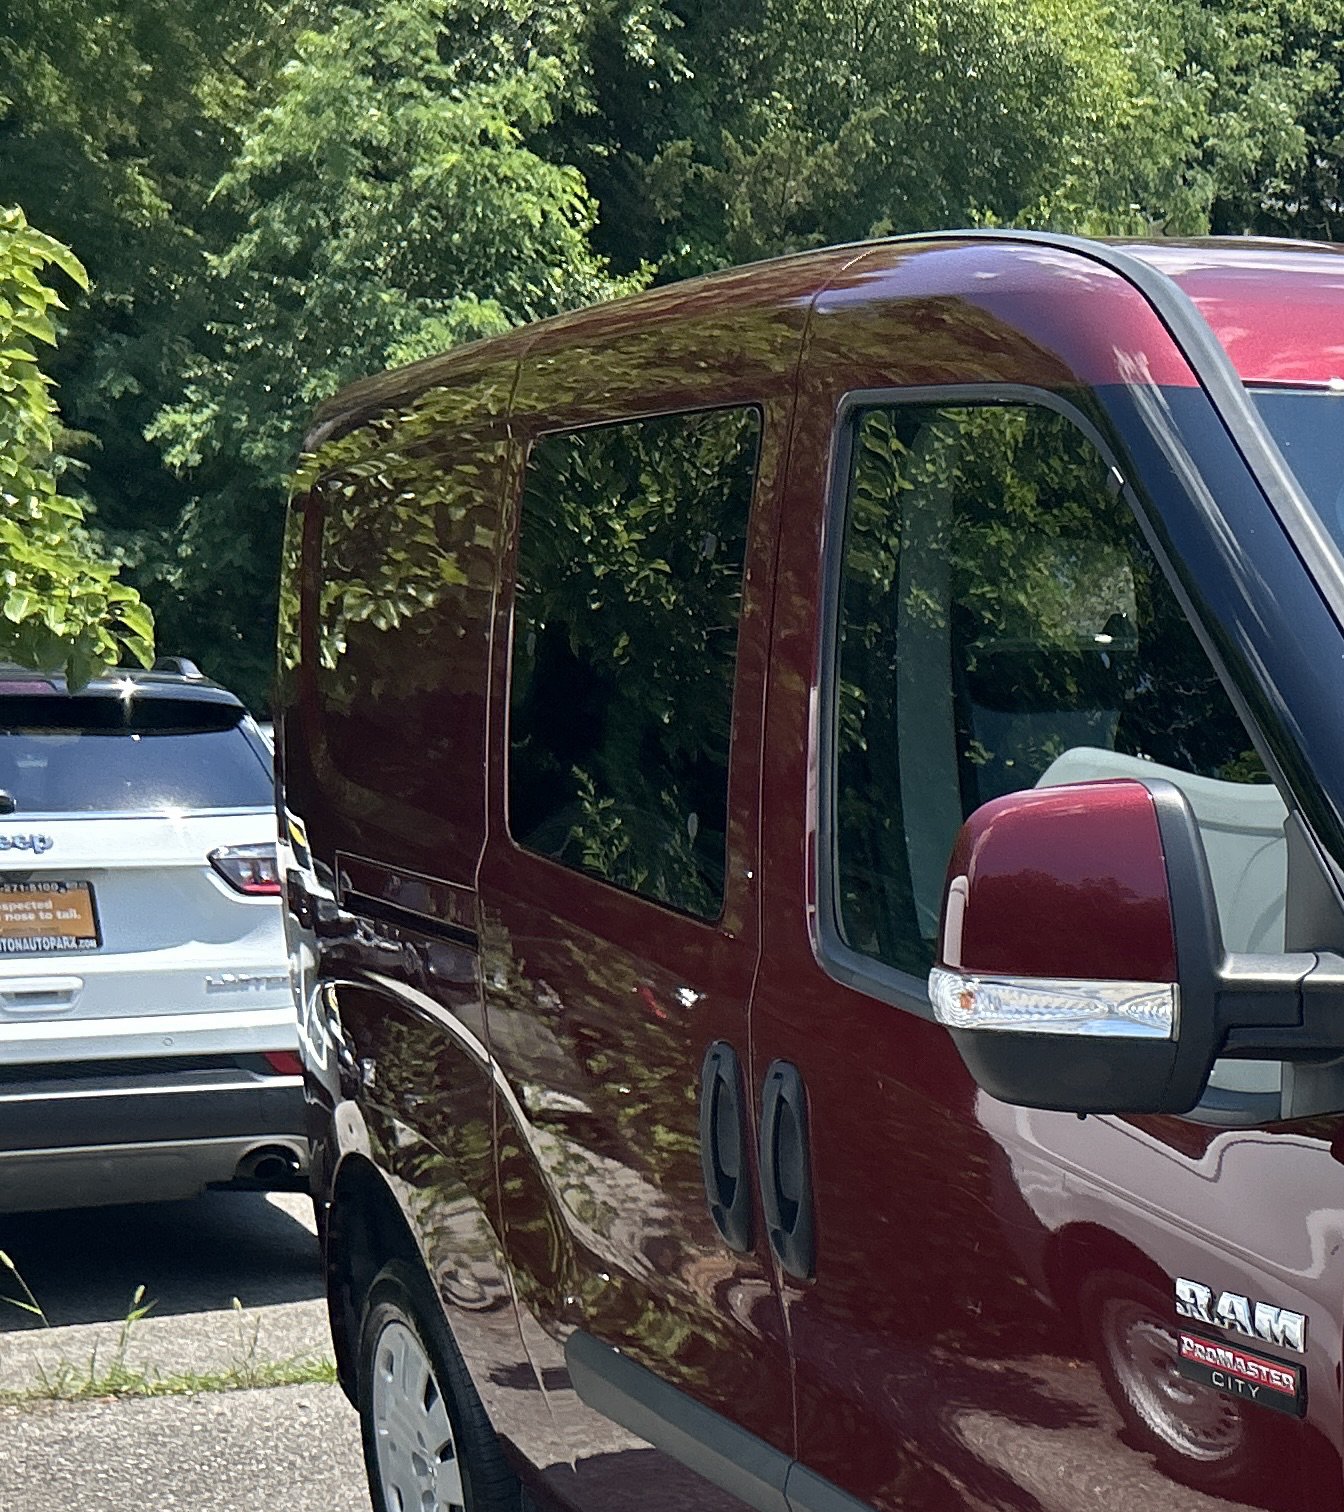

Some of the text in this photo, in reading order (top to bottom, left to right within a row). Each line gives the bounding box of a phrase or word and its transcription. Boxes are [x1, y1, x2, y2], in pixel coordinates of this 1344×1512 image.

[0, 834, 54, 854] eep
[5, 912, 35, 921] nose
[39, 911, 53, 920] to
[1175, 1277, 1309, 1353] RAM
[1211, 1371, 1260, 1399] CITY
